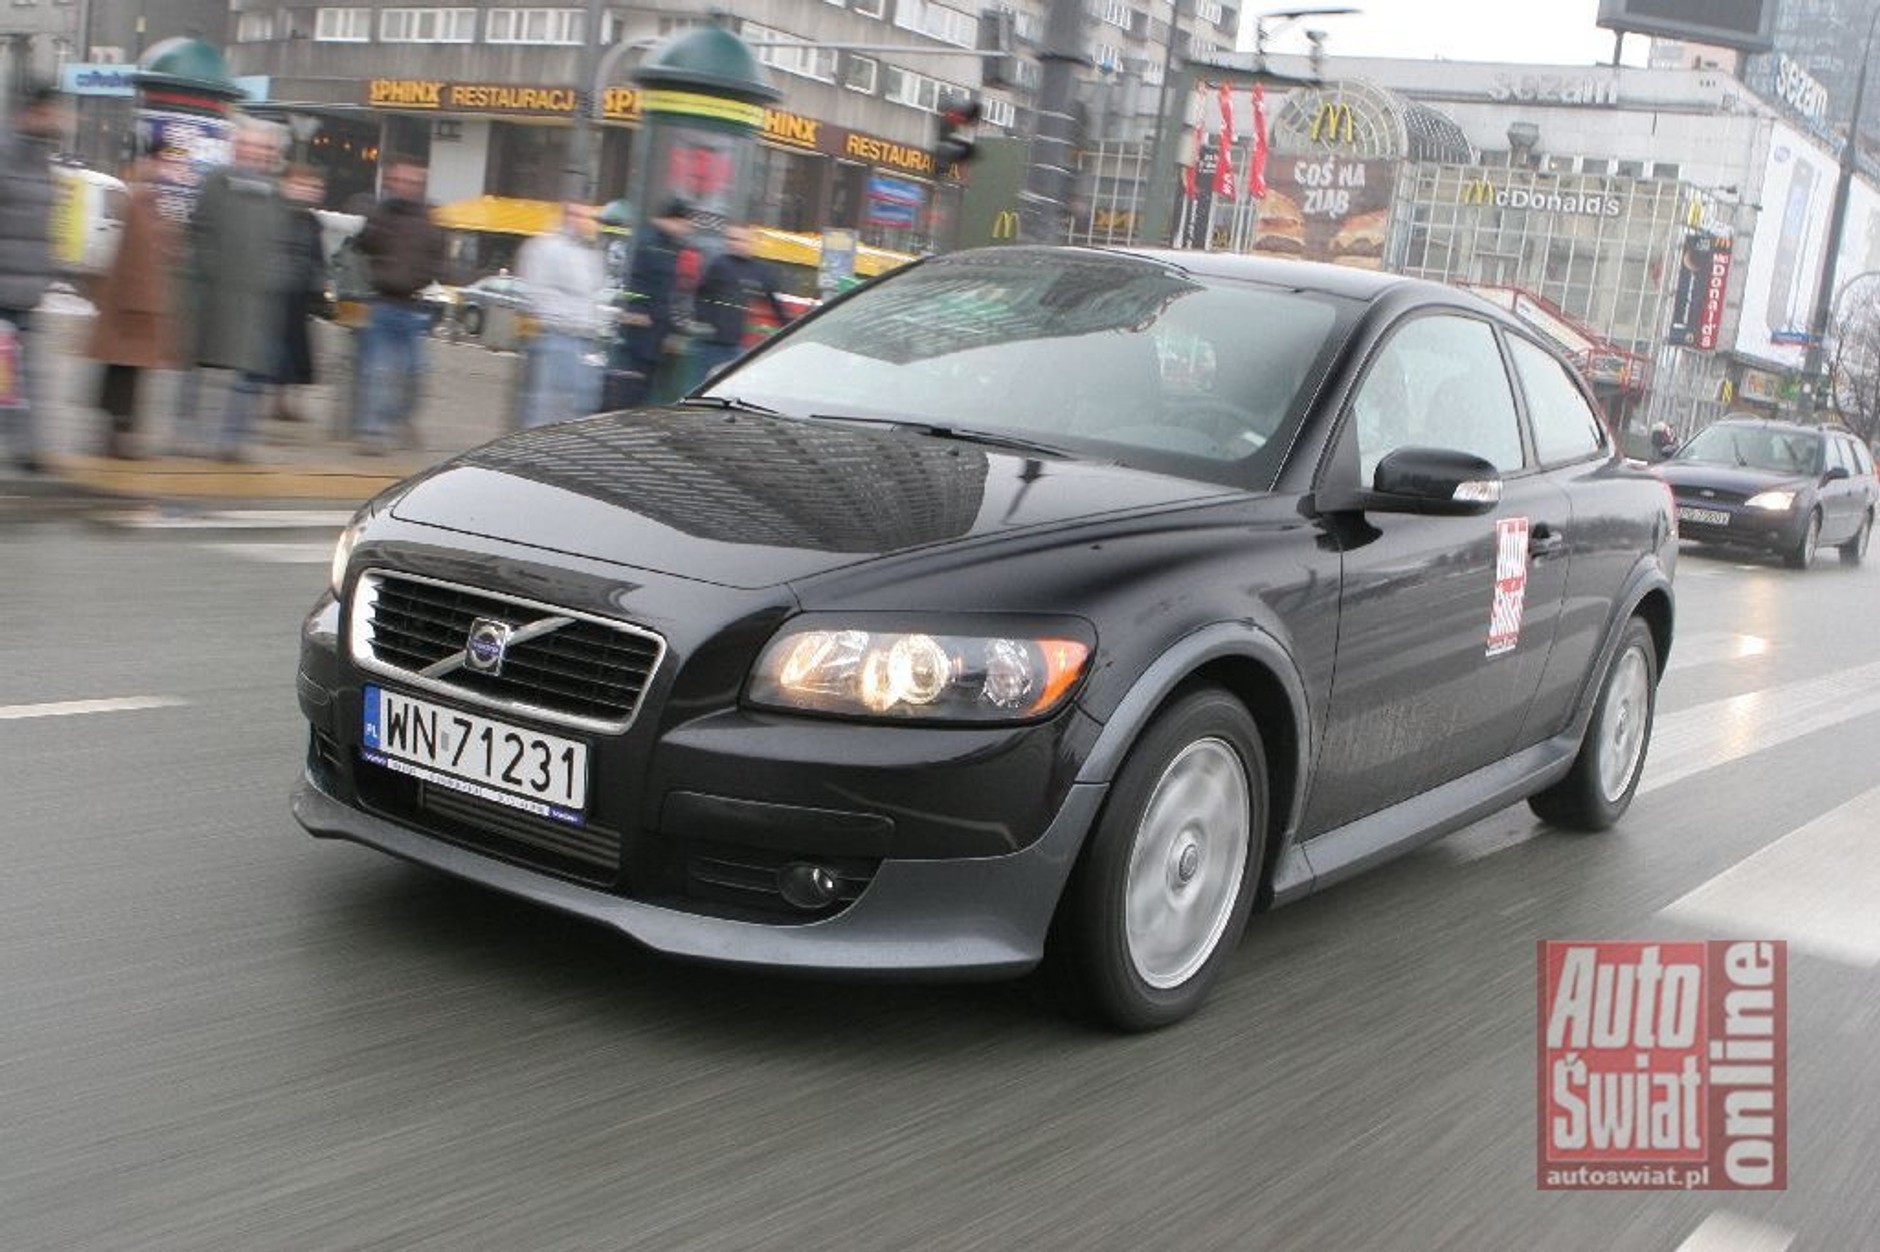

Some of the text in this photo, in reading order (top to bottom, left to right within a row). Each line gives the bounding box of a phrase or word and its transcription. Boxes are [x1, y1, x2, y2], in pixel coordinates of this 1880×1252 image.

[370, 78, 578, 111] SPHINX RESTAURACJ
[1338, 163, 1366, 188] NA
[366, 722, 379, 739] PL
[387, 697, 437, 763] WN
[451, 715, 576, 800] 71231
